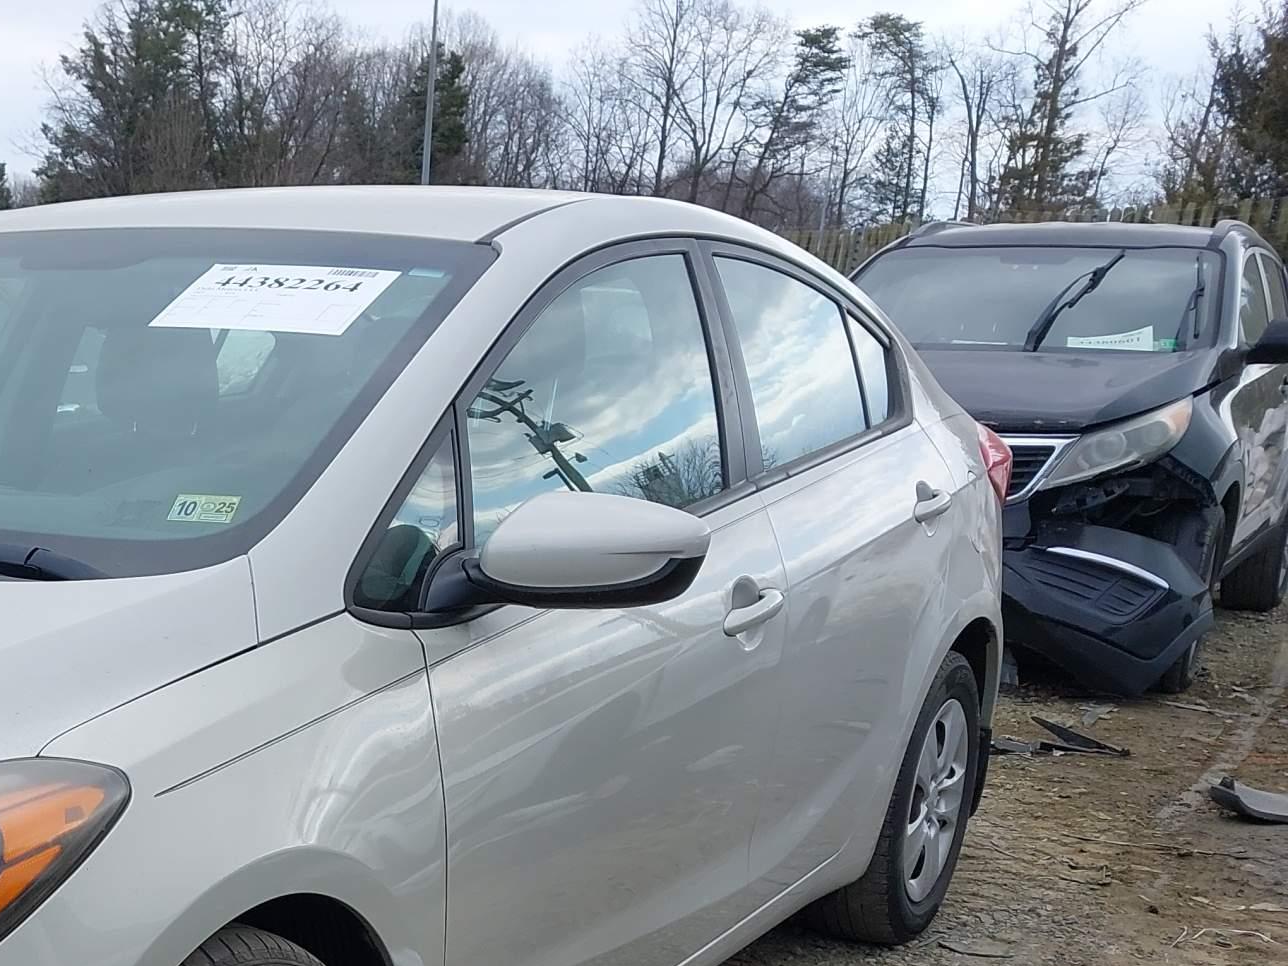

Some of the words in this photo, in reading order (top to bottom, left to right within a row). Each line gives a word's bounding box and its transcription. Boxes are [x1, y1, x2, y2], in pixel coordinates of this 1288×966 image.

[215, 275, 364, 293] 44382264
[177, 500, 198, 517] 10
[215, 501, 237, 514] 25
